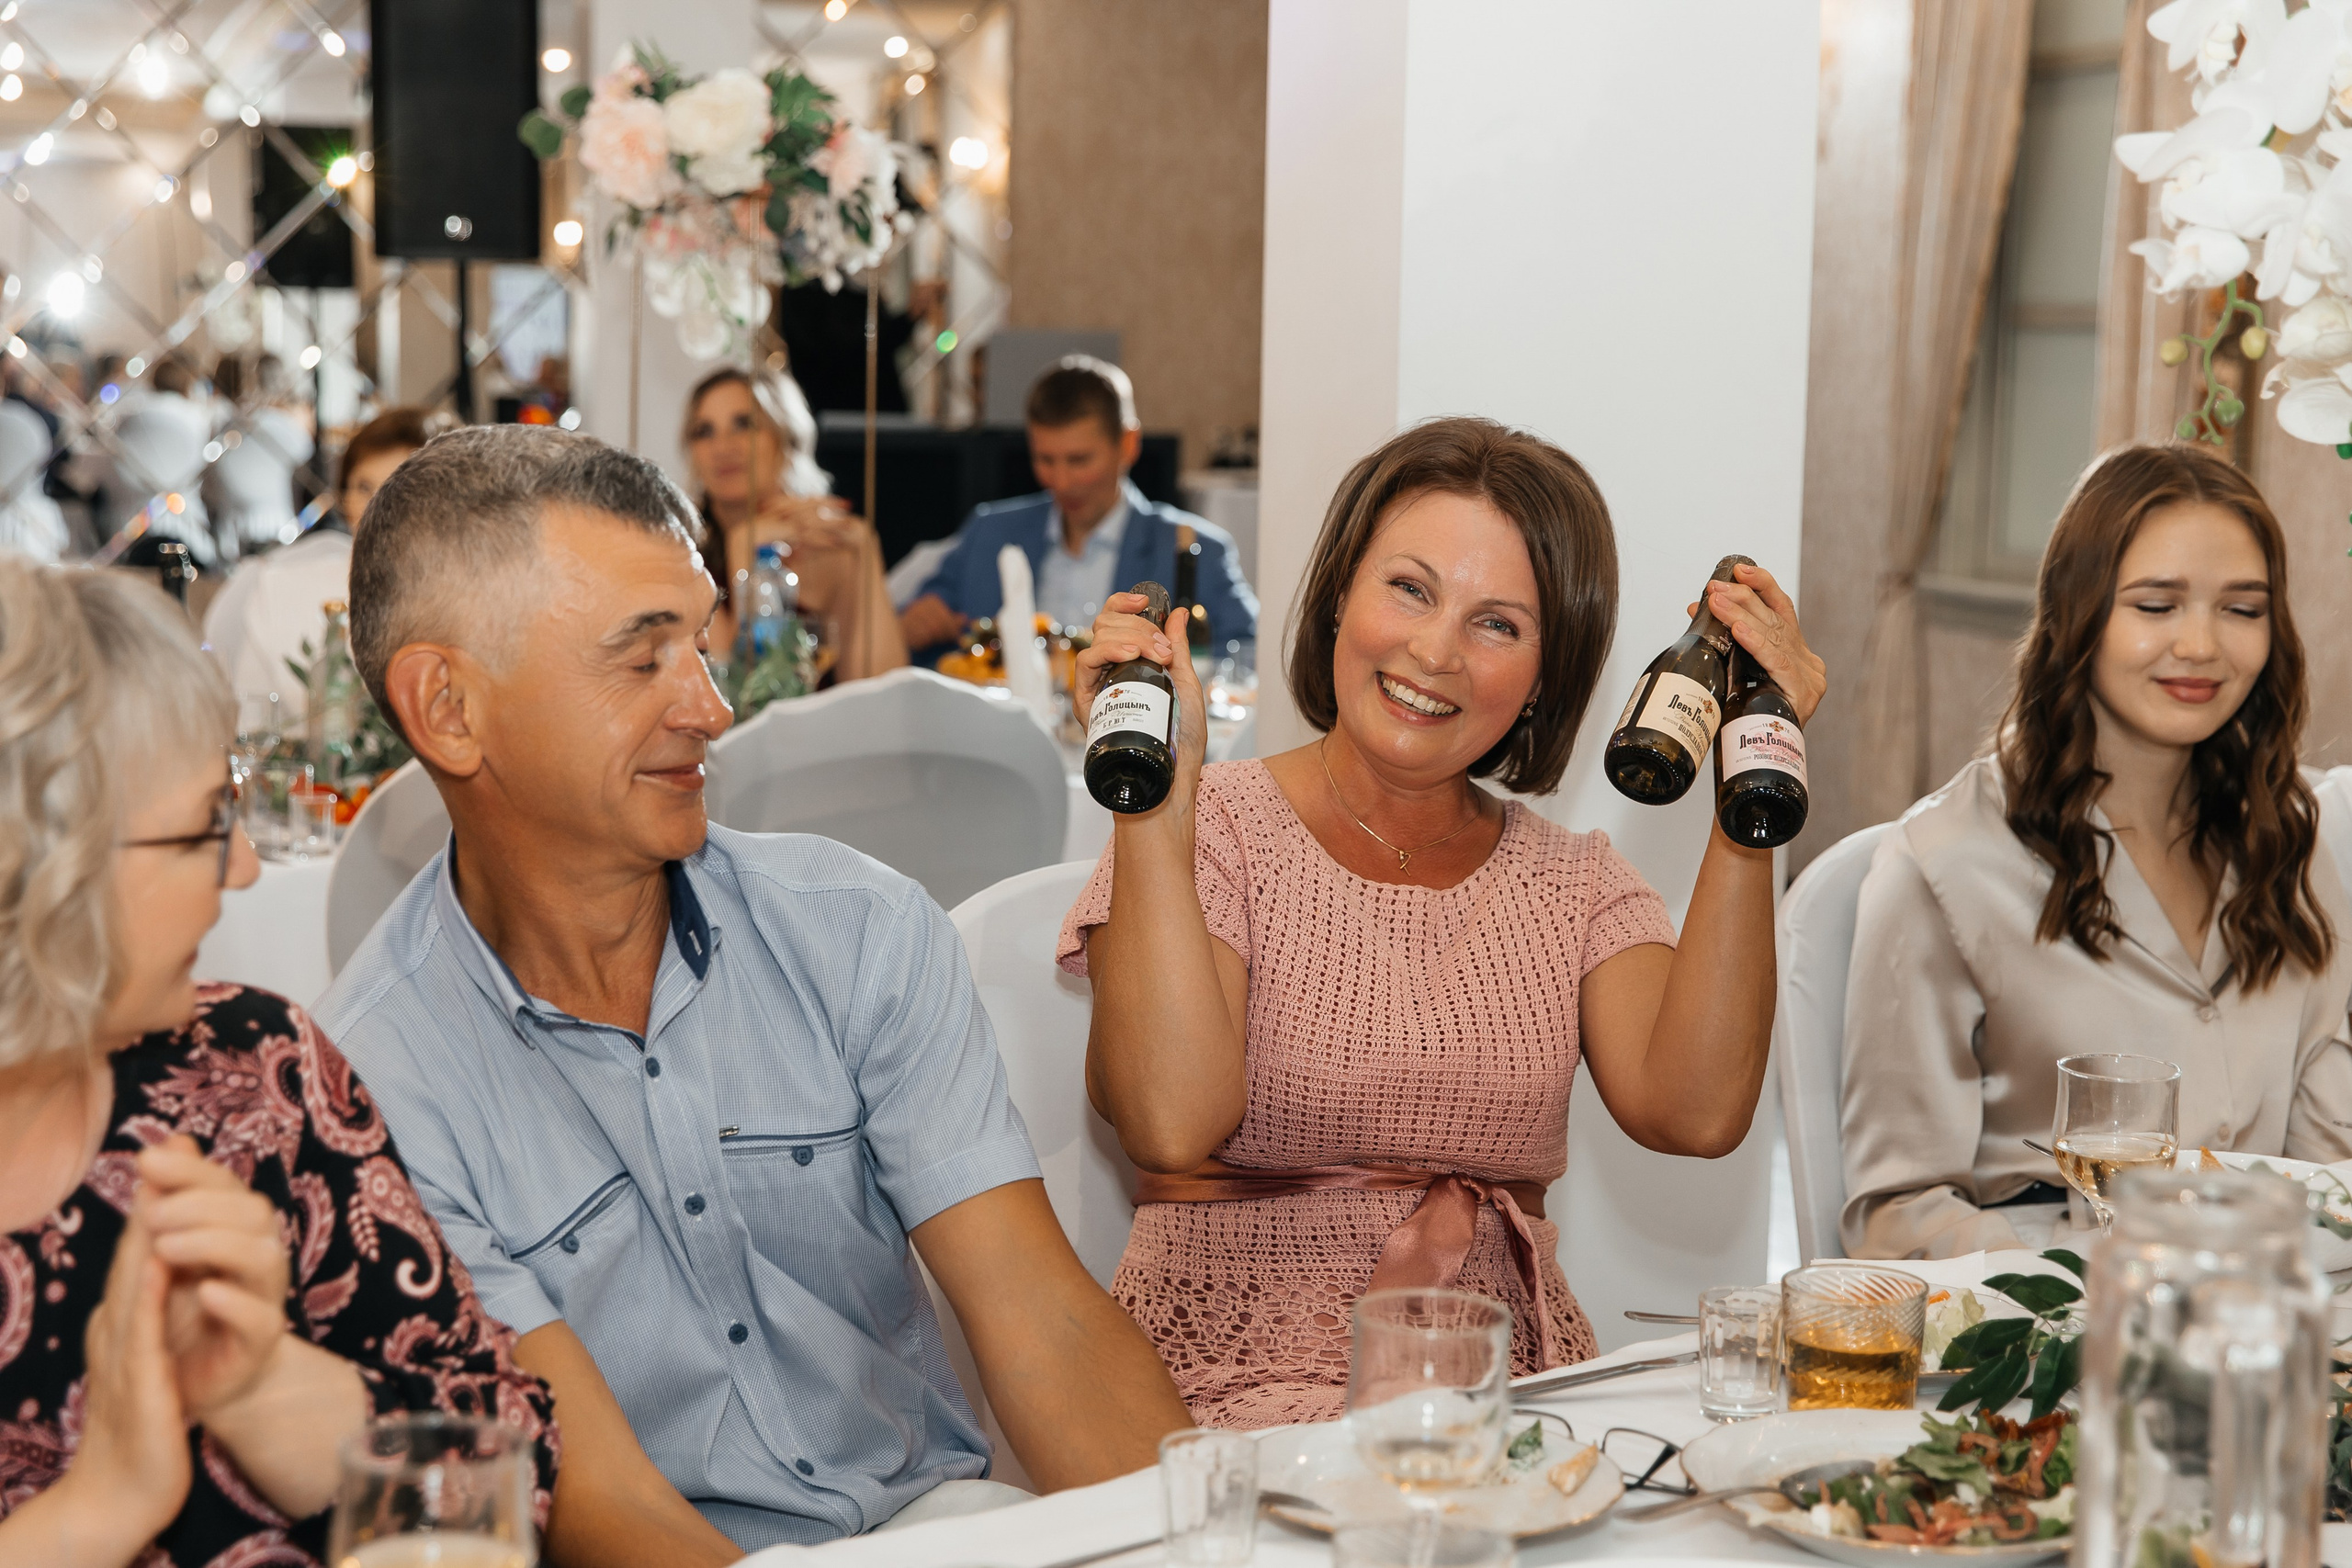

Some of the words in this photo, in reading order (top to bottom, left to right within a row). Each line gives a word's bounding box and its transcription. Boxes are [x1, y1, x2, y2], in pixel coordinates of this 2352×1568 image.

[1103, 701, 1151, 716] Голицынъ
[1668, 694, 1692, 716] Левъ
[1102, 716, 1126, 728] БРЮТ
[1739, 734, 1765, 750] Левъ
